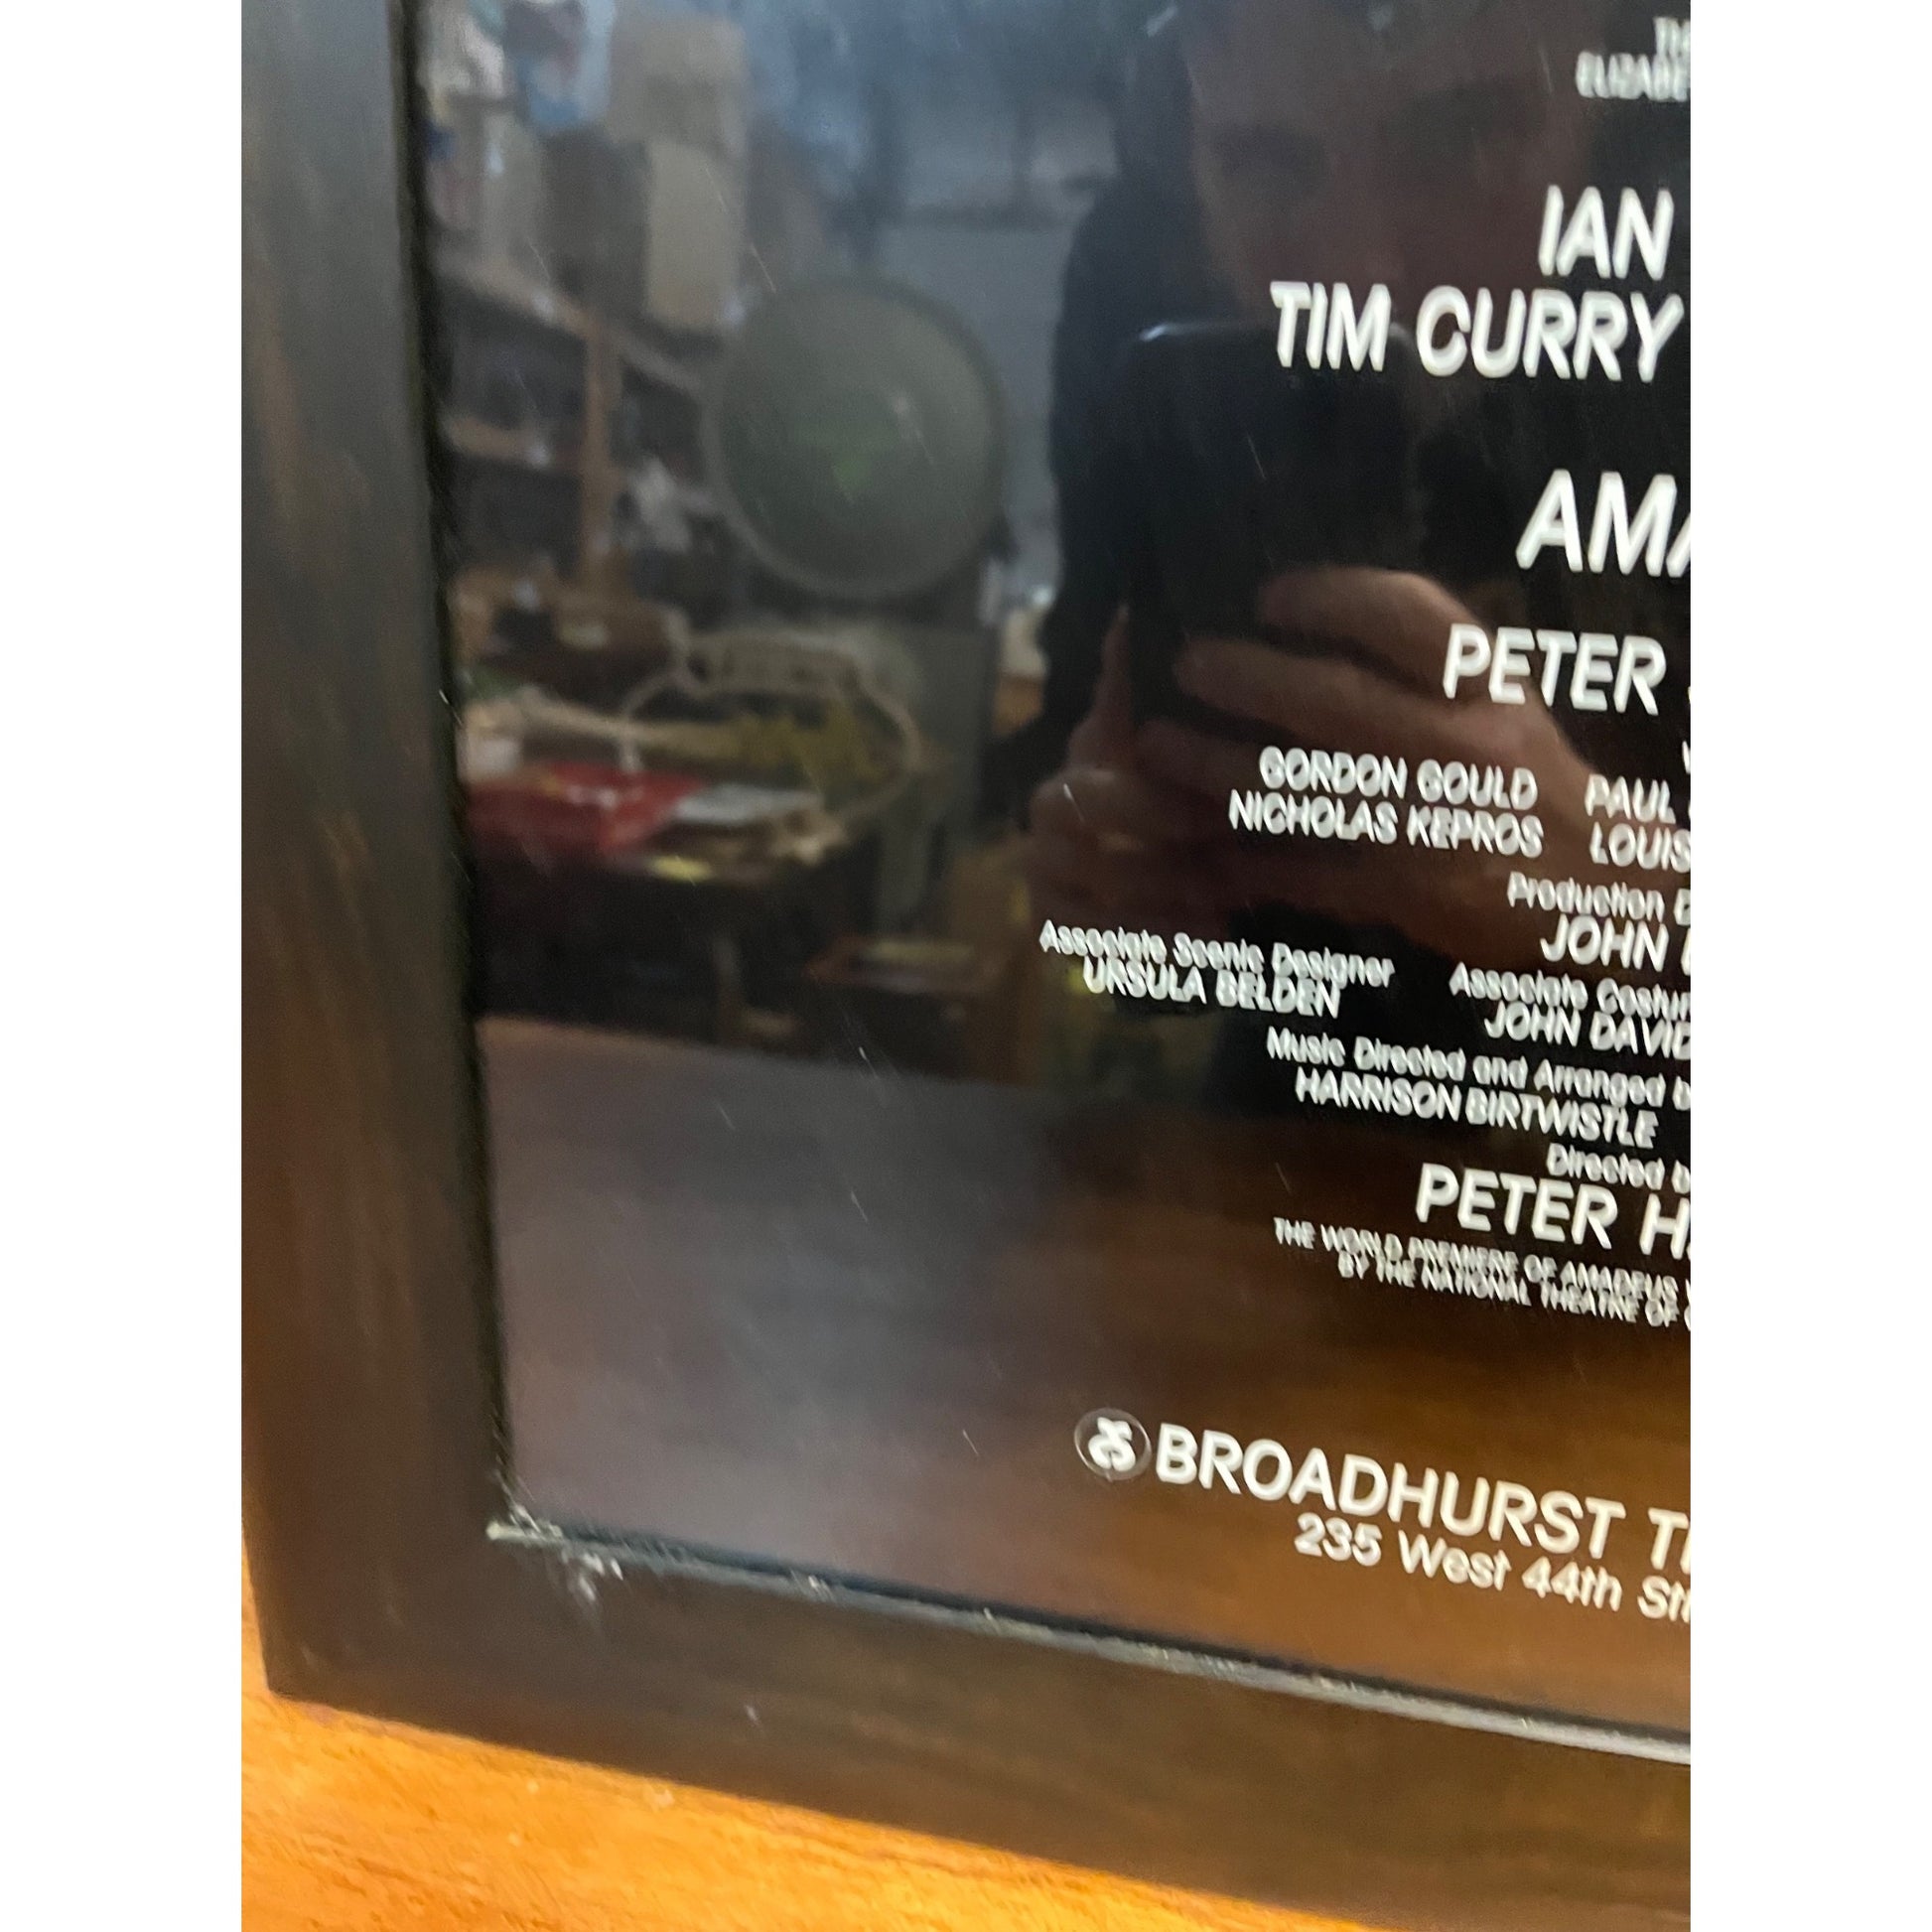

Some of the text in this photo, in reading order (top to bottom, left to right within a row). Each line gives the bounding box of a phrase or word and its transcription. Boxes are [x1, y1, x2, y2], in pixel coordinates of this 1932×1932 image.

[1538, 184, 1675, 281] IAN
[1270, 281, 1685, 383] TIM CURRY
[1443, 622, 1667, 716] PETER
[1259, 746, 1539, 810] GORDON GOULD
[1586, 773, 1677, 824] PAUL
[1229, 789, 1545, 858] NICHOLAS KEPROS
[1589, 821, 1690, 873] LOUIS
[1507, 871, 1665, 922] Production
[1038, 919, 1395, 989] Associate Scenic Designer
[1540, 913, 1670, 972] JOHN
[1083, 955, 1340, 1019] URSULA BELDEN
[1449, 961, 1588, 1011] Associate
[1484, 1000, 1582, 1047] JOHN
[1267, 1026, 1345, 1067] Music
[1354, 1035, 1466, 1082] Directed
[1472, 1055, 1529, 1090] and
[1534, 1058, 1666, 1108] Arranged
[1296, 1066, 1659, 1149] HARRISON BIRTWISTLE
[1546, 1143, 1666, 1190] Directed
[1415, 1163, 1690, 1260] PETER H
[1273, 1216, 1679, 1303] THE WORLD PREMIERE OF AMADEUS
[1337, 1250, 1680, 1327] BY THE NATIONAL THEATRE OF
[1156, 1422, 1690, 1575] BROADHURST T
[1294, 1512, 1383, 1567] 235
[1398, 1530, 1511, 1590] West
[1521, 1556, 1623, 1612] 44th
